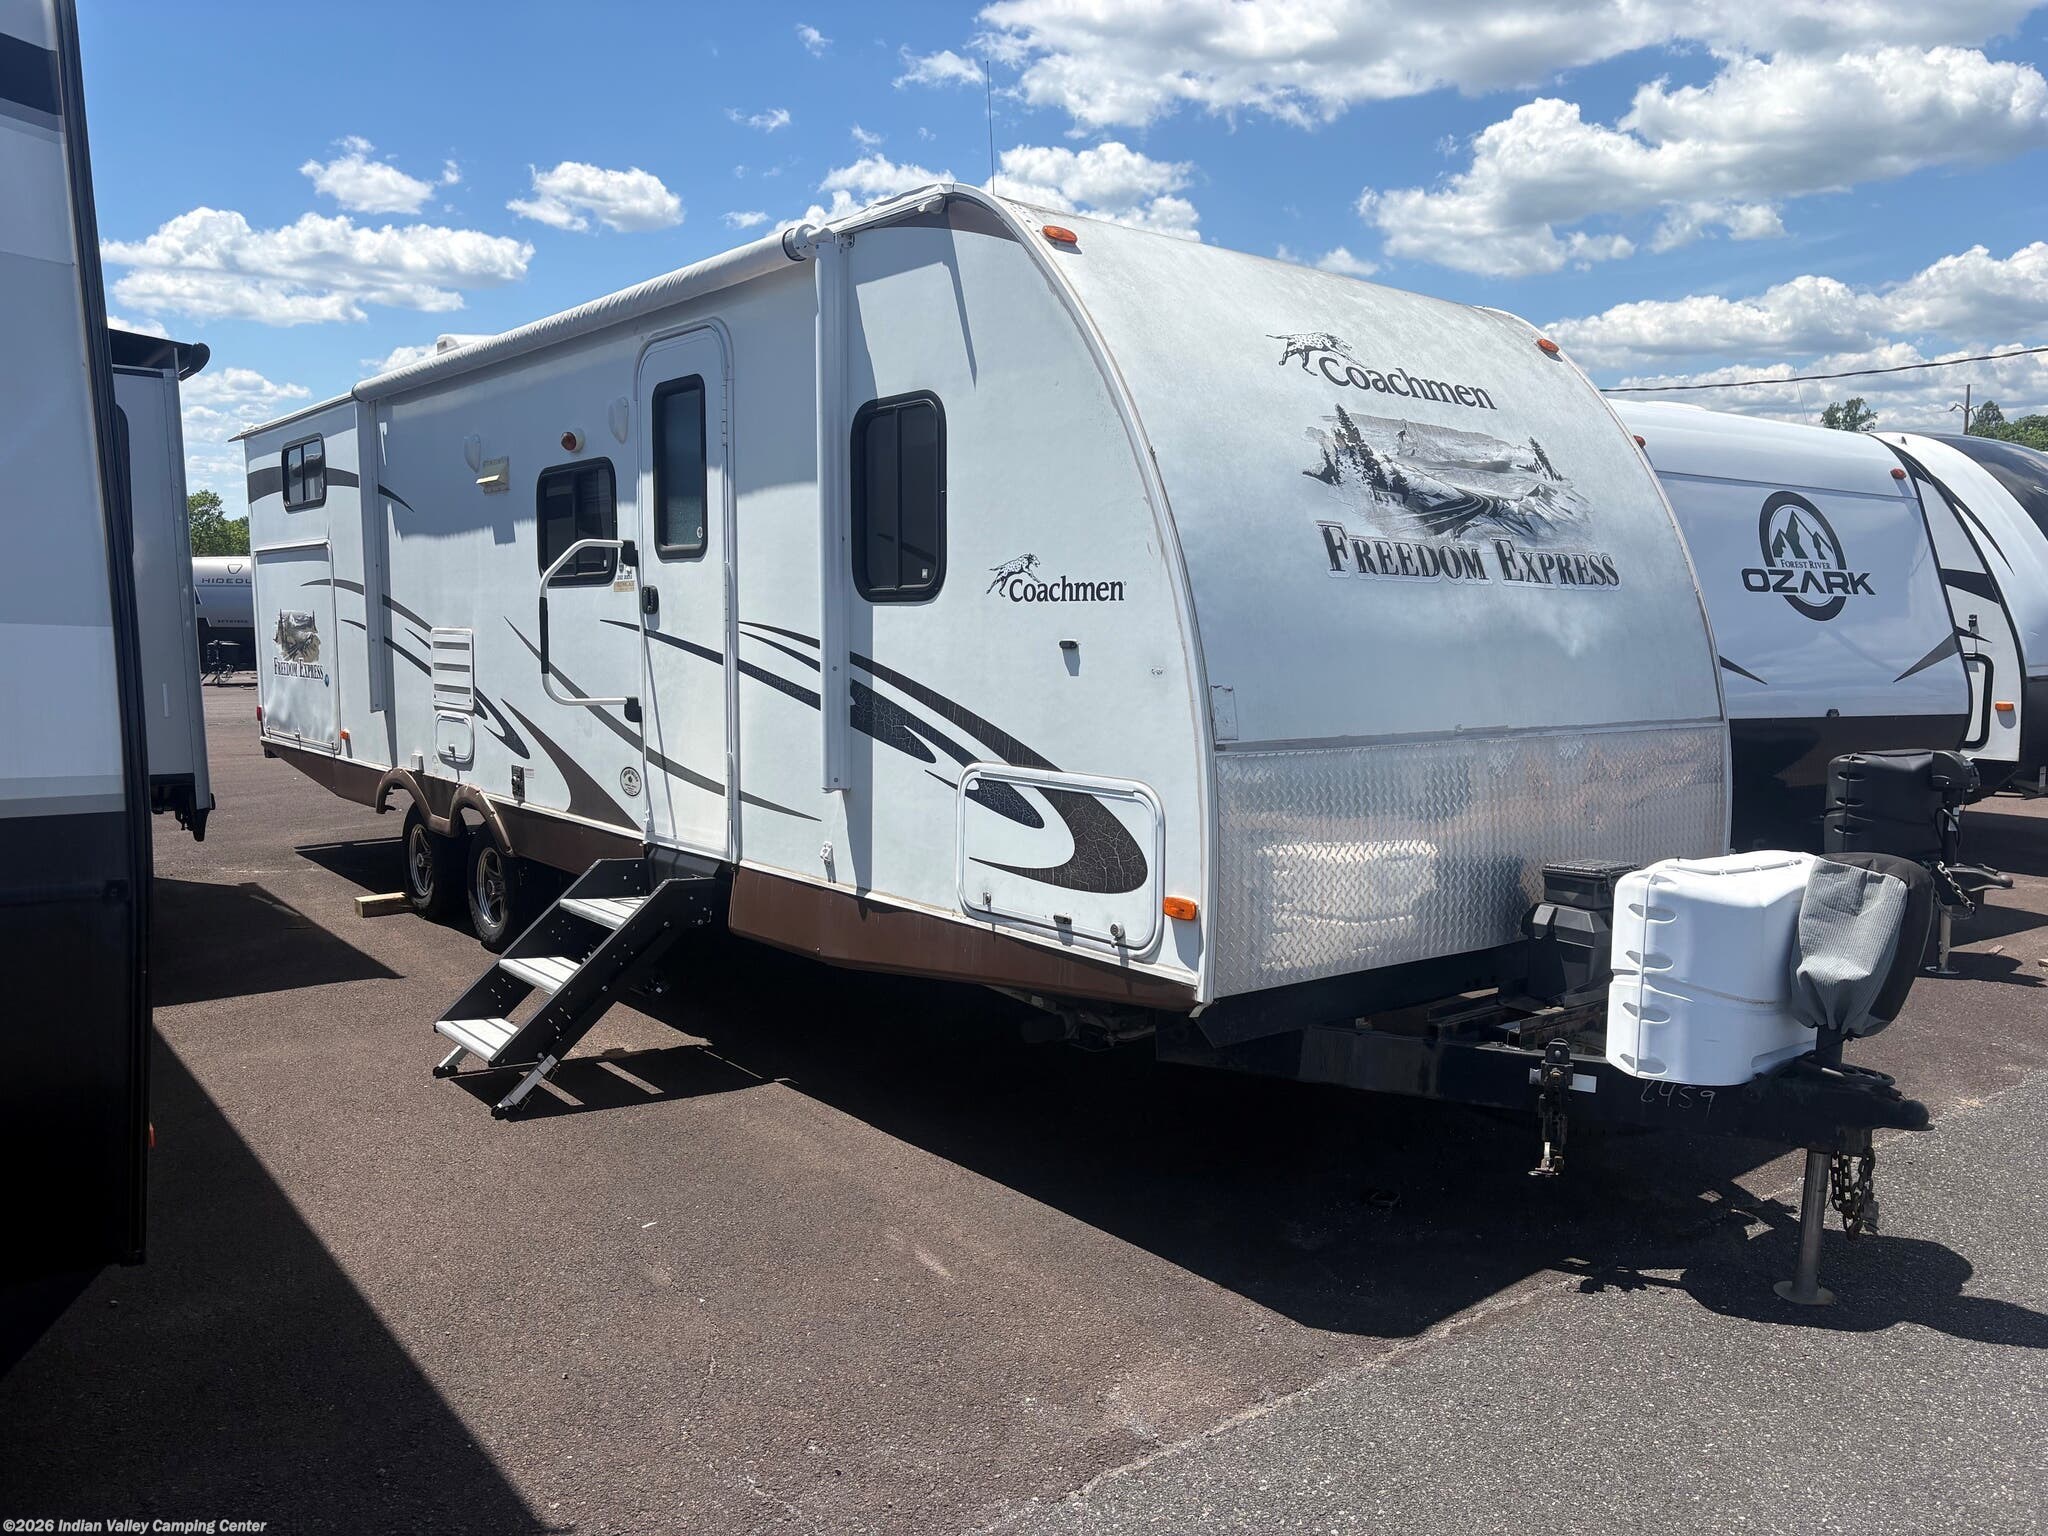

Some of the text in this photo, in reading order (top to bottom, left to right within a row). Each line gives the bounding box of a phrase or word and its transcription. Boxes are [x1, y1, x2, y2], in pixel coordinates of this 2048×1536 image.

[1318, 356, 1498, 410] Coachmen
[1009, 575, 1125, 602] Coachmen
[1741, 568, 1876, 595] OZARK
